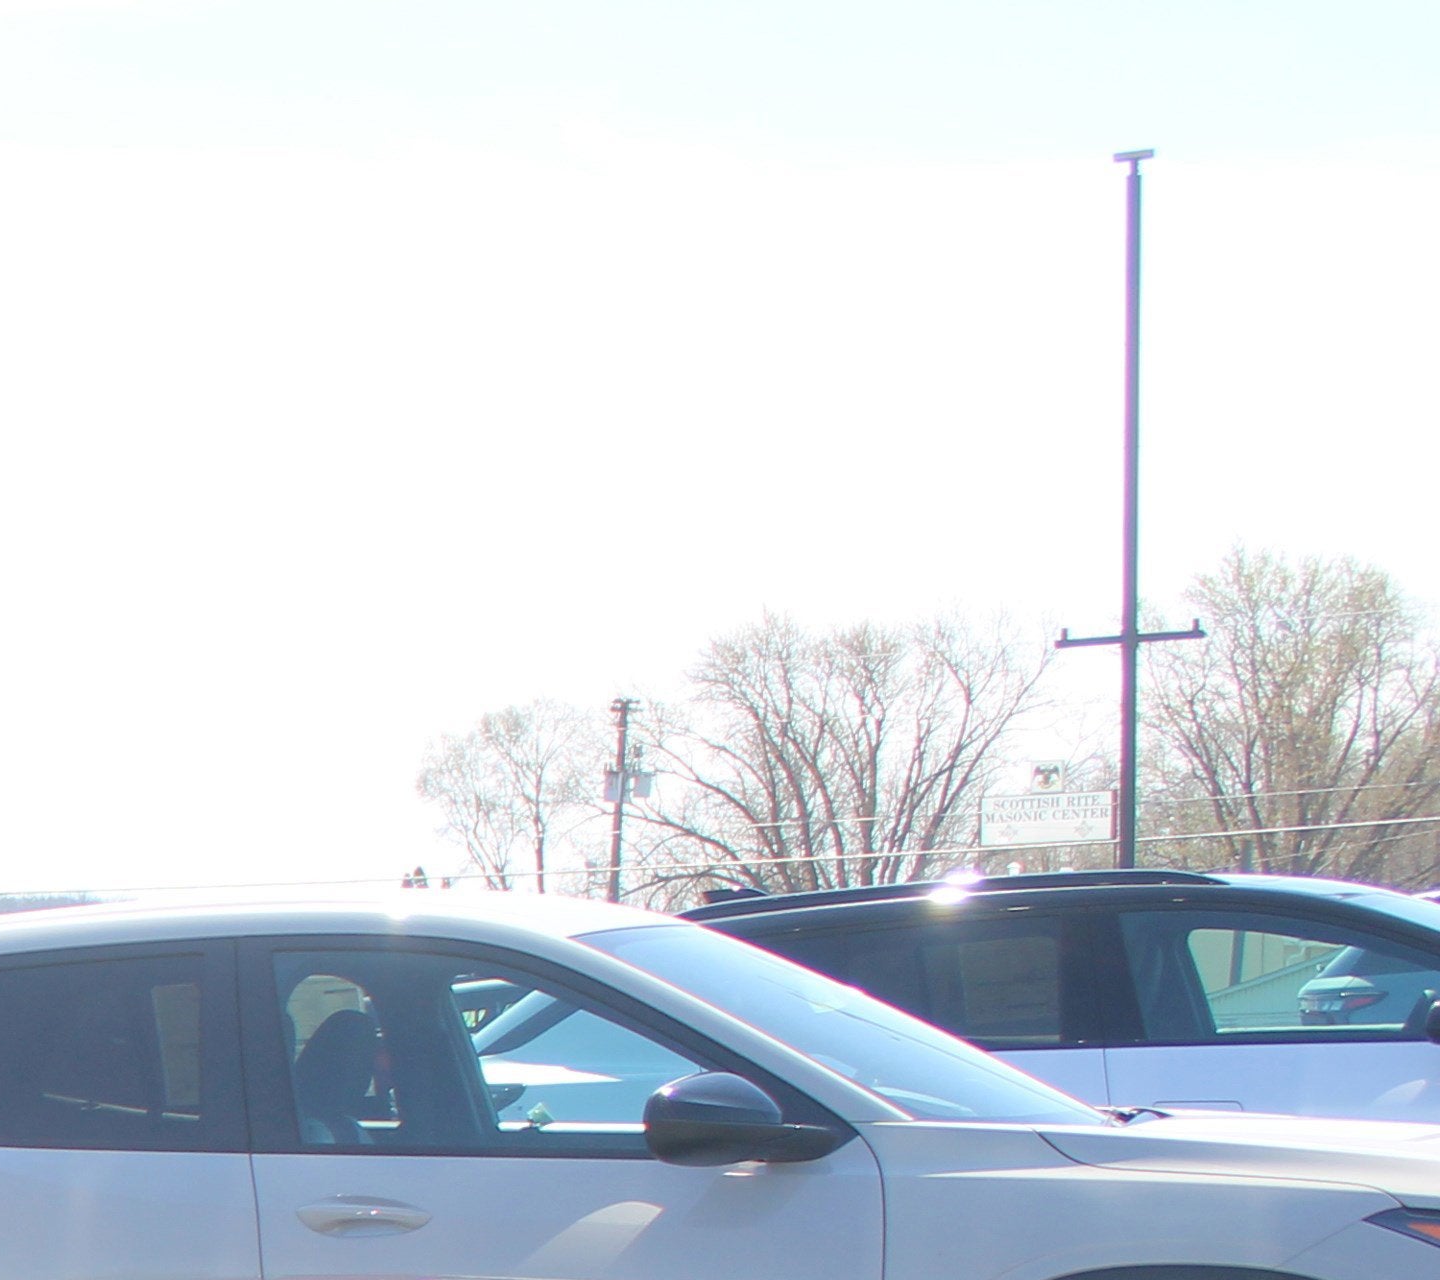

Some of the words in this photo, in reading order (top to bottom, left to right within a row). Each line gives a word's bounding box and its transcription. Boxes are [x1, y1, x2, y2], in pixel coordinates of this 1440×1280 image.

[993, 797, 1060, 811] SCOTTISH
[1067, 795, 1101, 807] RITE
[985, 810, 1048, 824] MASONIC
[1052, 807, 1110, 820] CENTER
